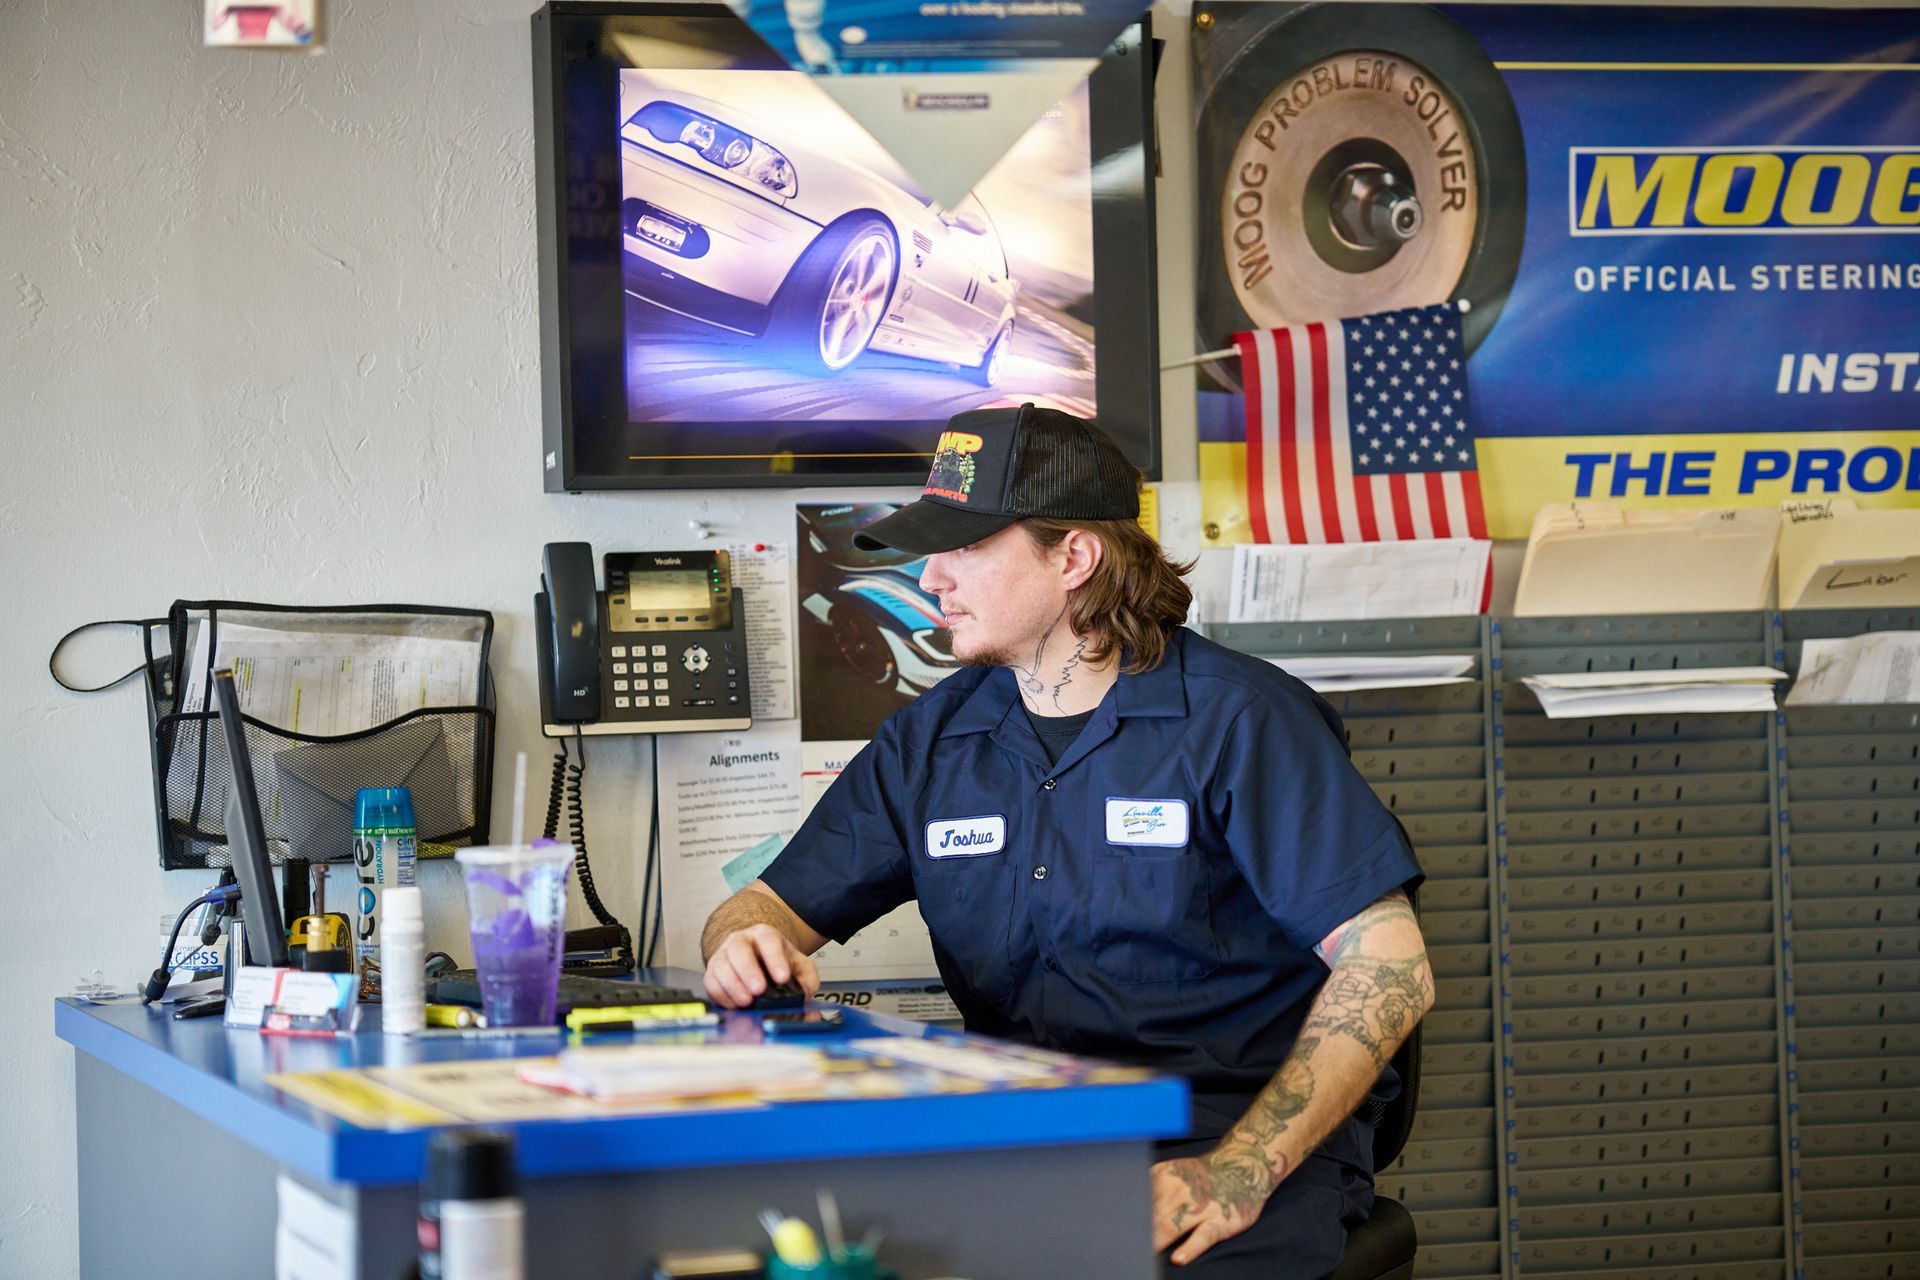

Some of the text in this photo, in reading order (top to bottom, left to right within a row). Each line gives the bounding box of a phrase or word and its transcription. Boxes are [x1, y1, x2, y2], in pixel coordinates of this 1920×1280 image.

[1233, 57, 1467, 290] MOOG PROBLEM SOLVER
[1578, 153, 1920, 228] MOOG
[1573, 263, 1920, 292] OFFICIAL STEERING
[1776, 352, 1920, 394] INST
[1564, 451, 1716, 499] THE
[820, 505, 854, 517] FORD
[573, 689, 586, 697] HD
[709, 751, 780, 767] Alignments
[824, 761, 848, 770] MAR
[939, 828, 995, 849] Joshua
[374, 839, 385, 885] HYDRATION
[353, 837, 377, 942] core
